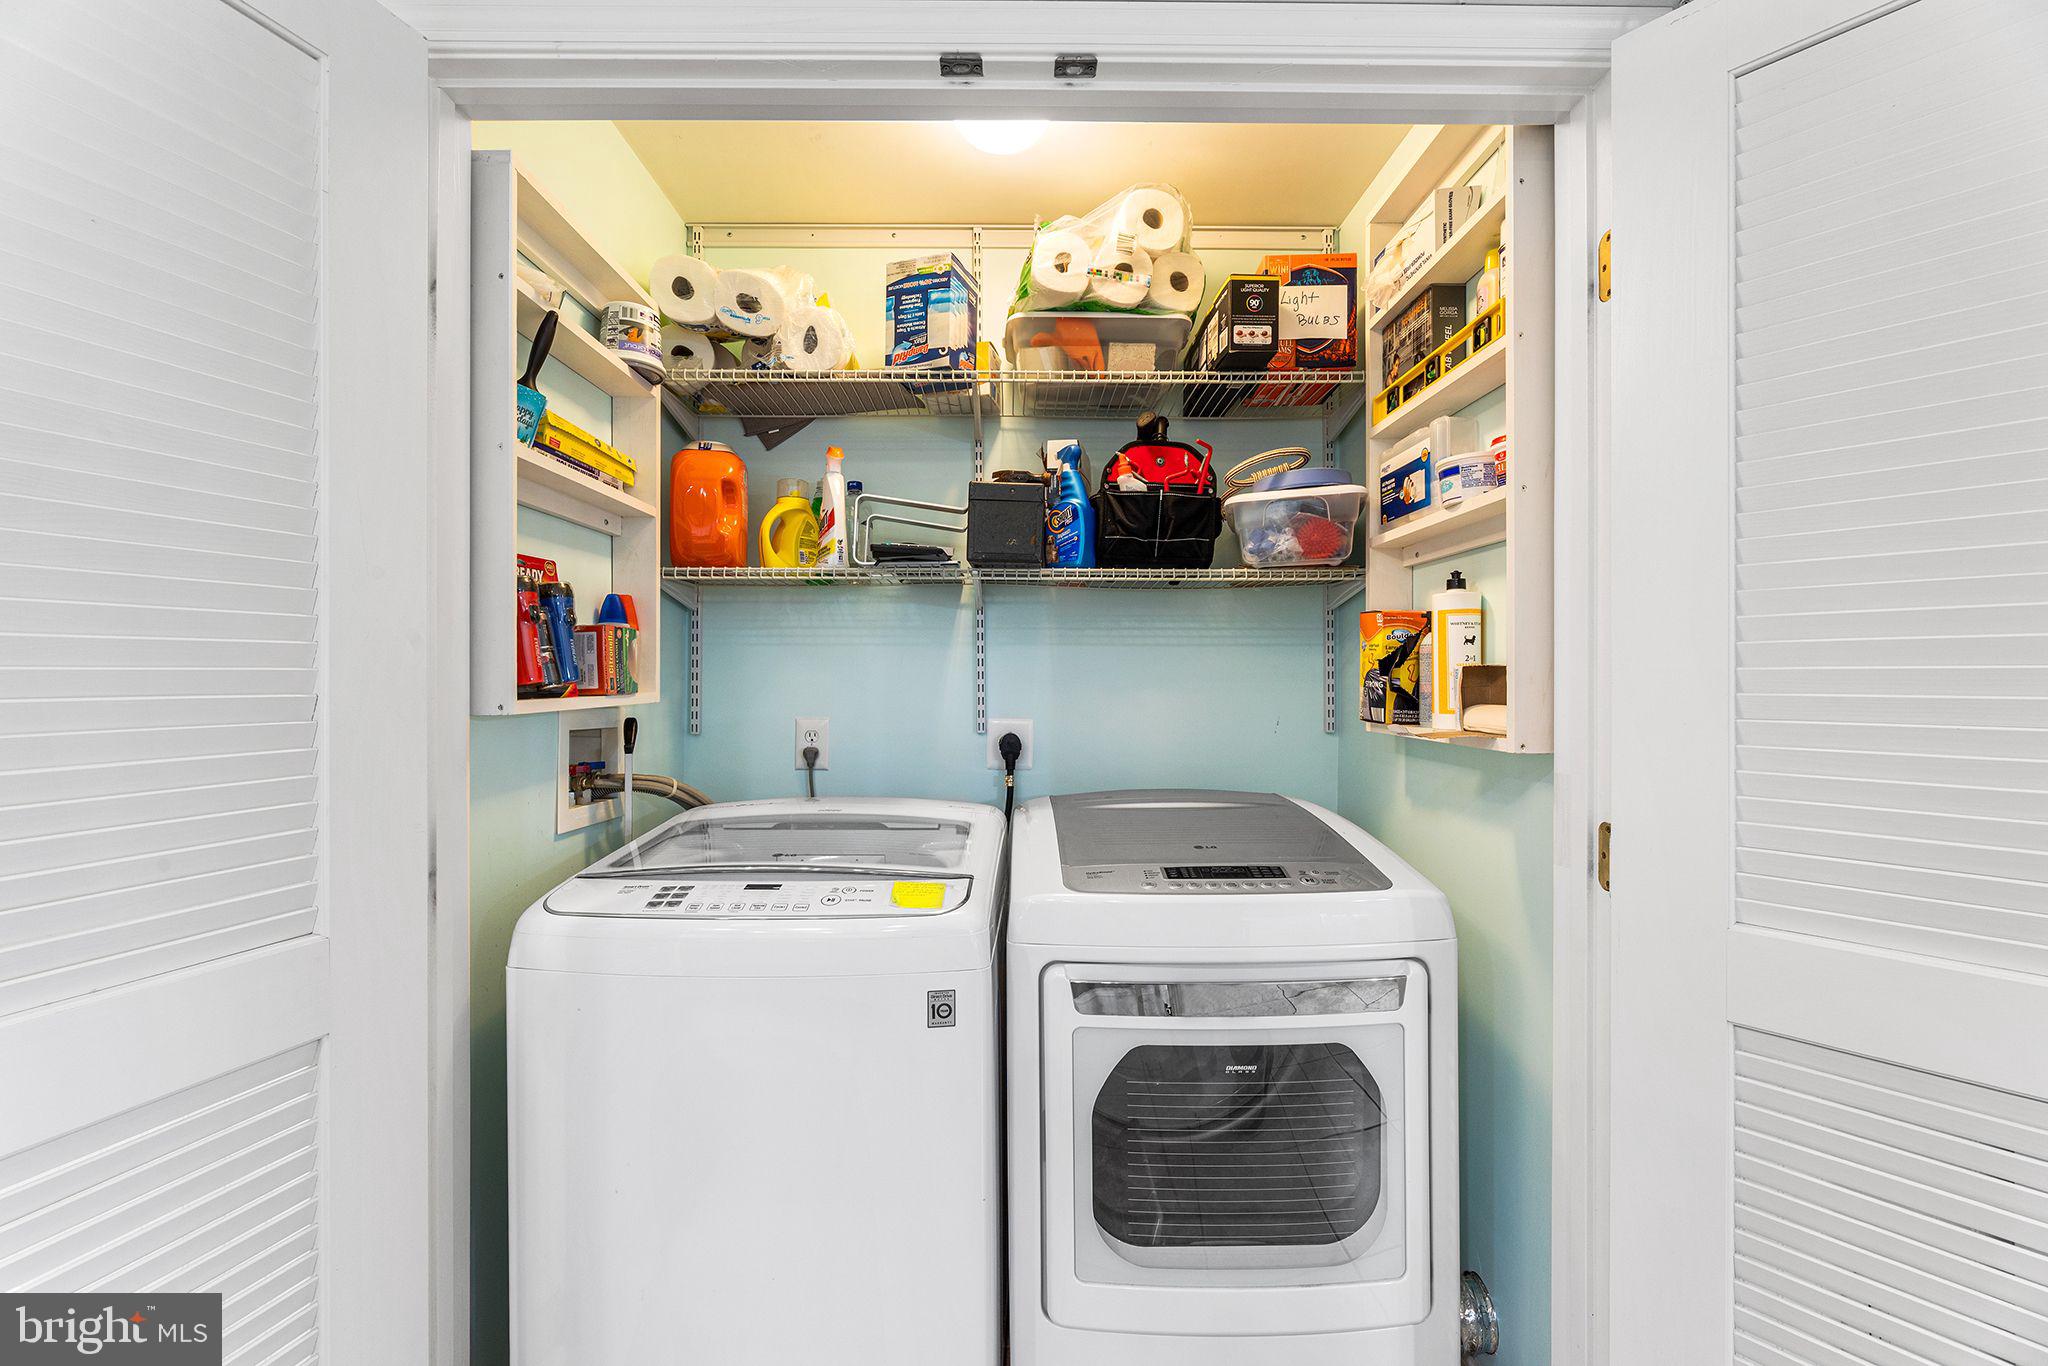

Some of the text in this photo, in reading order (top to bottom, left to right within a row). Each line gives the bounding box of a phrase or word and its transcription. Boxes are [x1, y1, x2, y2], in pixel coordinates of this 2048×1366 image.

[1280, 290, 1319, 312] Light
[1296, 314, 1341, 327] BULBS
[891, 343, 929, 368] DampRid
